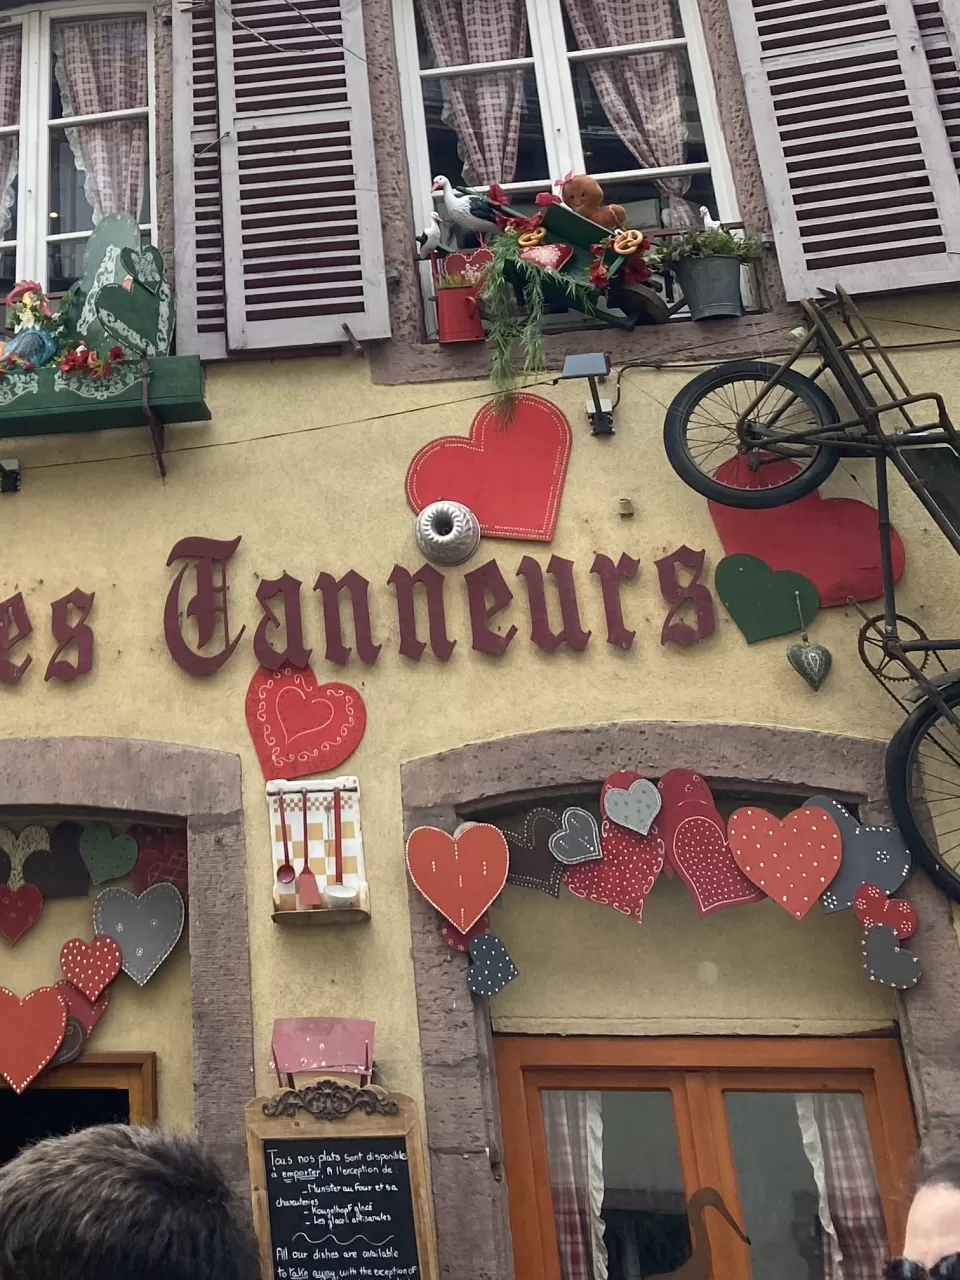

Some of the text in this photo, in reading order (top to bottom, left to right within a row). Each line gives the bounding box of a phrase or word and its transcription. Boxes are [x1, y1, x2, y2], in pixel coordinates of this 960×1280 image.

[164, 534, 718, 678] Tanneurs
[267, 1149, 293, 1166] Tous
[298, 1153, 316, 1163] nos
[318, 1150, 341, 1168] plats
[342, 1185, 354, 1193] au
[375, 1182, 385, 1191] et
[276, 1246, 400, 1261] All our dishes are available
[277, 1266, 287, 1278] to
[339, 1266, 357, 1277] with
[360, 1266, 372, 1276] the
[373, 1265, 408, 1279] exception
